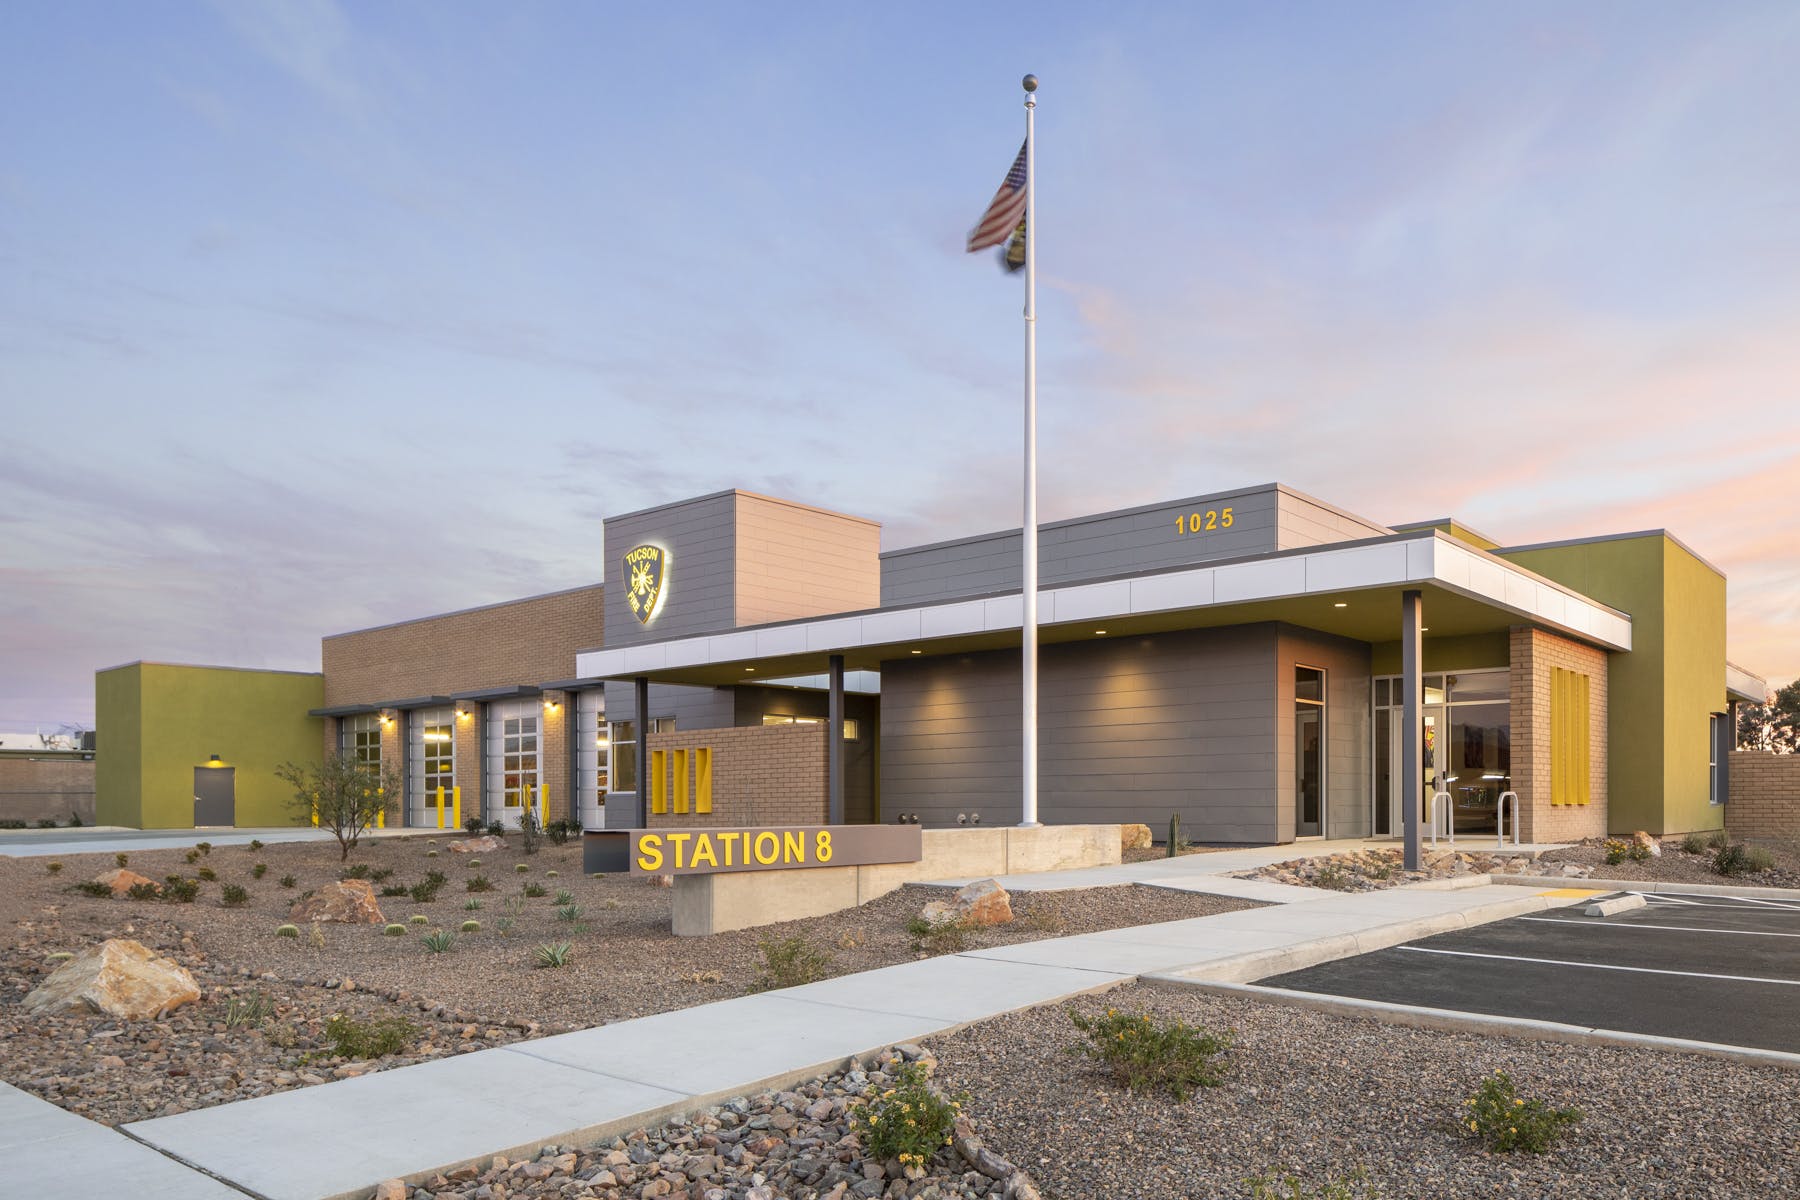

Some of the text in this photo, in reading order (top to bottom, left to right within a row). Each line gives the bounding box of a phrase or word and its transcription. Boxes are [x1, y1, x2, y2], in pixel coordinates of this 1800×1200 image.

[1175, 507, 1234, 534] 1025
[626, 547, 659, 565] TUCSON
[627, 591, 640, 612] FIRE
[637, 830, 833, 871] STATION 8
